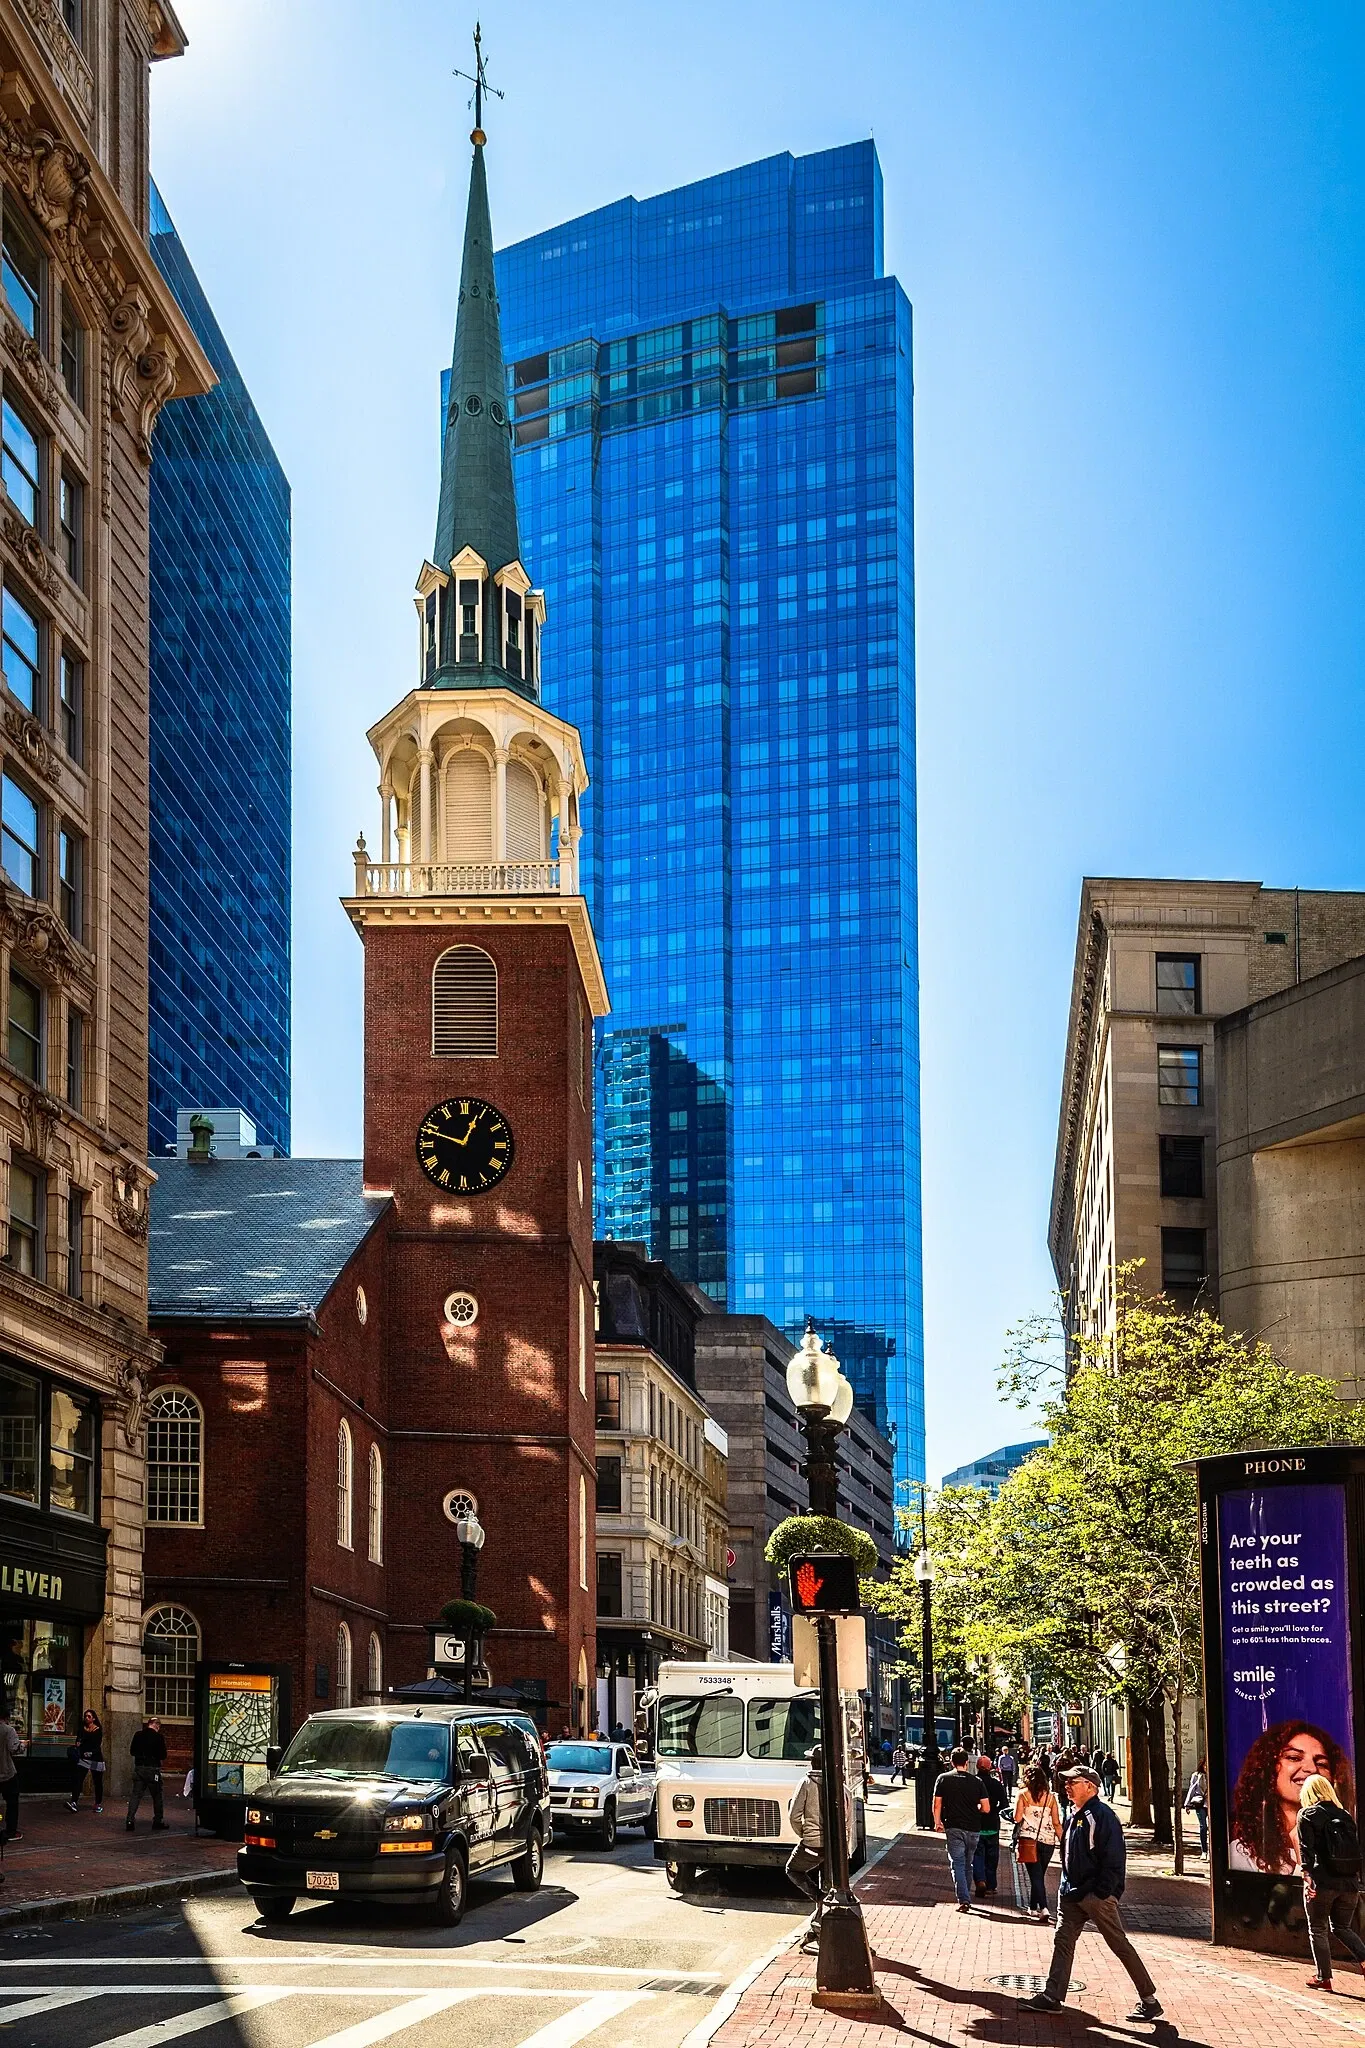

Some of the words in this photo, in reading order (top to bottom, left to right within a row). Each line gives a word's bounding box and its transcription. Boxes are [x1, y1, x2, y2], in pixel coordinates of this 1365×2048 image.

[1244, 1458, 1306, 1475] PHONE
[1229, 1534, 1256, 1549] Are
[1260, 1533, 1302, 1550] your
[1230, 1553, 1272, 1570] teeth
[1277, 1556, 1299, 1567] as
[1231, 1575, 1305, 1592] crowded
[1310, 1579, 1334, 1590] as
[1231, 1599, 1260, 1614] this
[1264, 1598, 1331, 1613] street?
[771, 1605, 782, 1655] Marshalls
[1251, 1625, 1269, 1633] smile
[1270, 1625, 1291, 1634] you'll
[1233, 1665, 1276, 1682] smile
[221, 1679, 251, 1687] Information
[1234, 1687, 1257, 1701] DIRECT
[1258, 1687, 1276, 1700] CLUB
